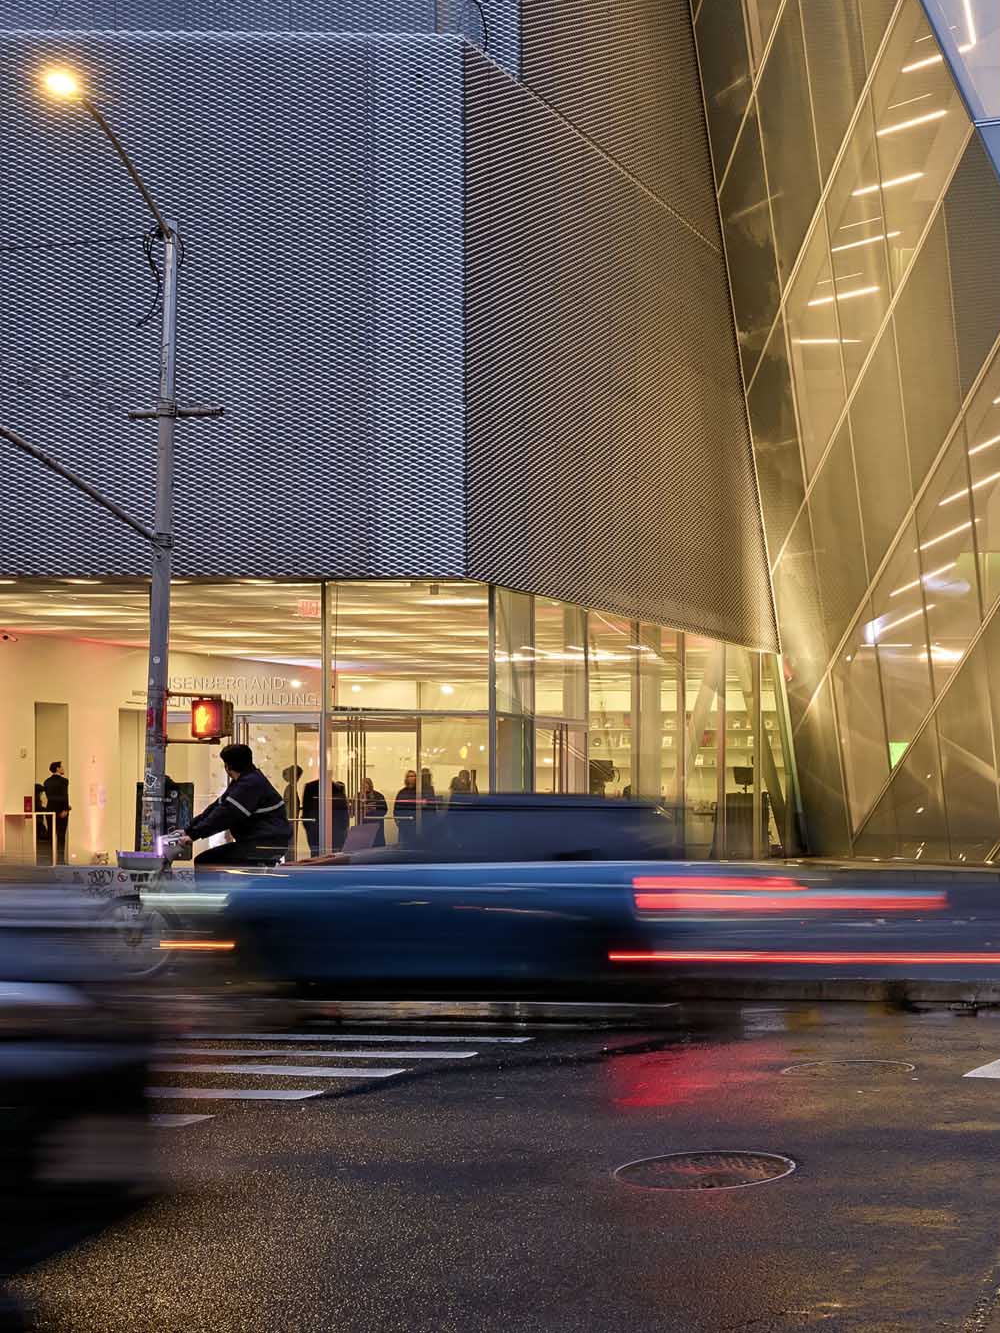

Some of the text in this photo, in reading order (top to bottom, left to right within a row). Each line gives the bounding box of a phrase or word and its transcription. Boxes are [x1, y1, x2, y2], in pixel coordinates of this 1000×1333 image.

[168, 675, 285, 691] ISENBERG AND
[244, 693, 319, 707] BUILDING
